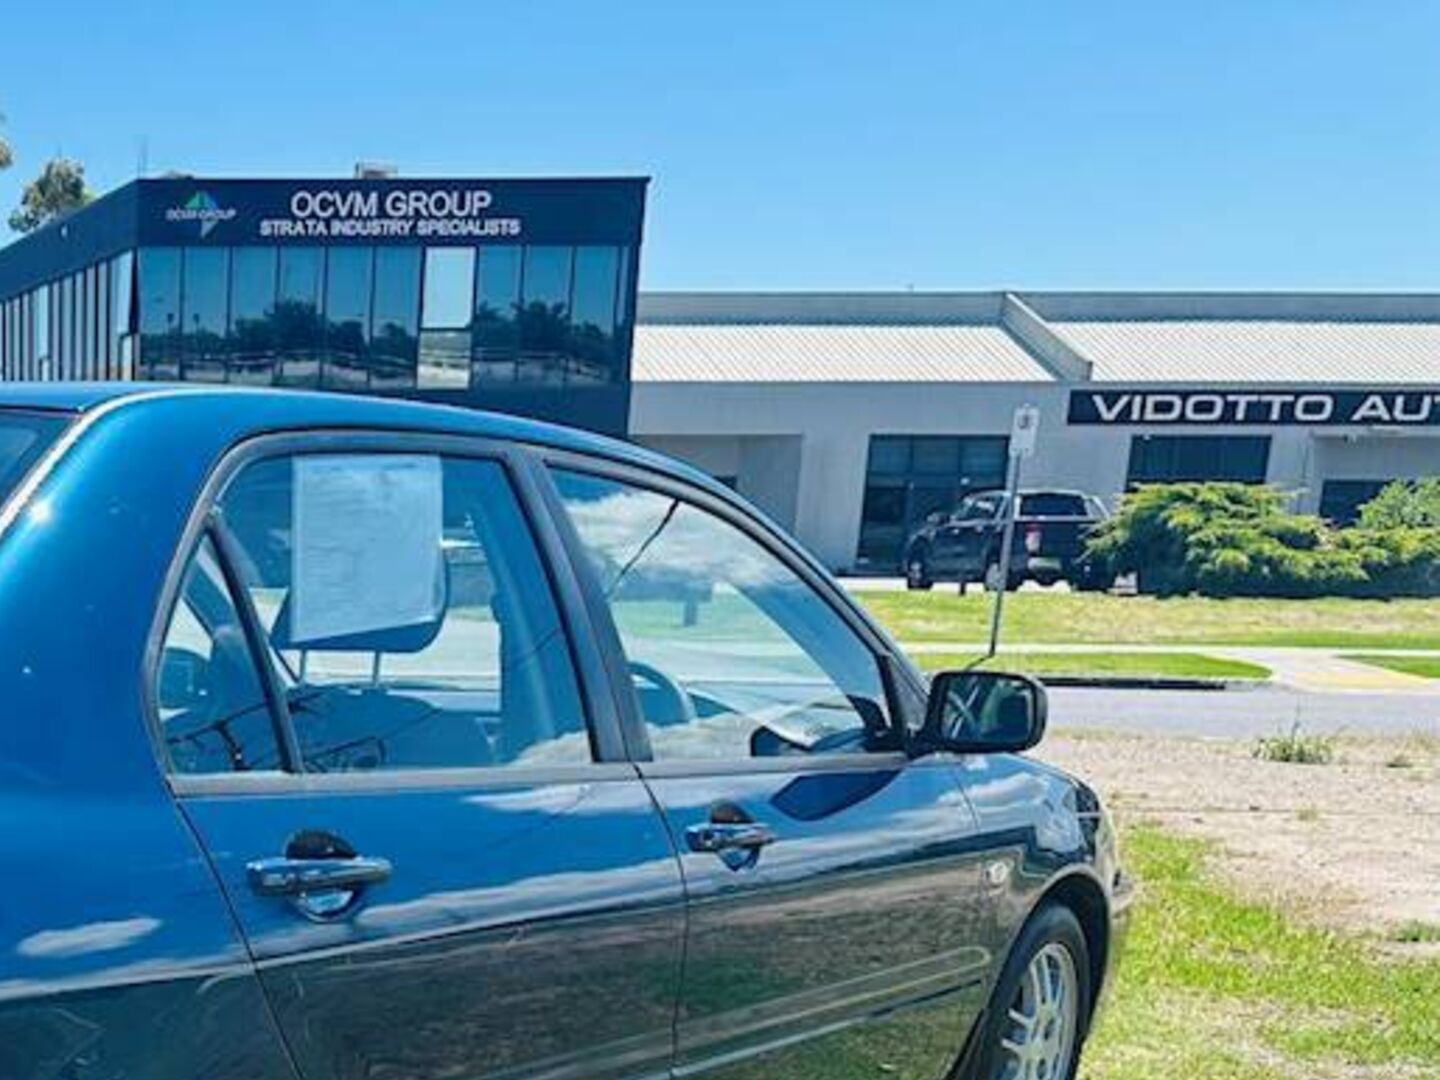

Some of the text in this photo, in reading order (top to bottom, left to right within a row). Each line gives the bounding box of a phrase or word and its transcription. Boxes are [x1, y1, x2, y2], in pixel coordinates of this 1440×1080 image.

[290, 190, 493, 218] OCVM GROUP
[260, 218, 522, 236] STRATA INDUSTRY SPECIALISTS
[1092, 393, 1440, 421] VIDOTTO AU
